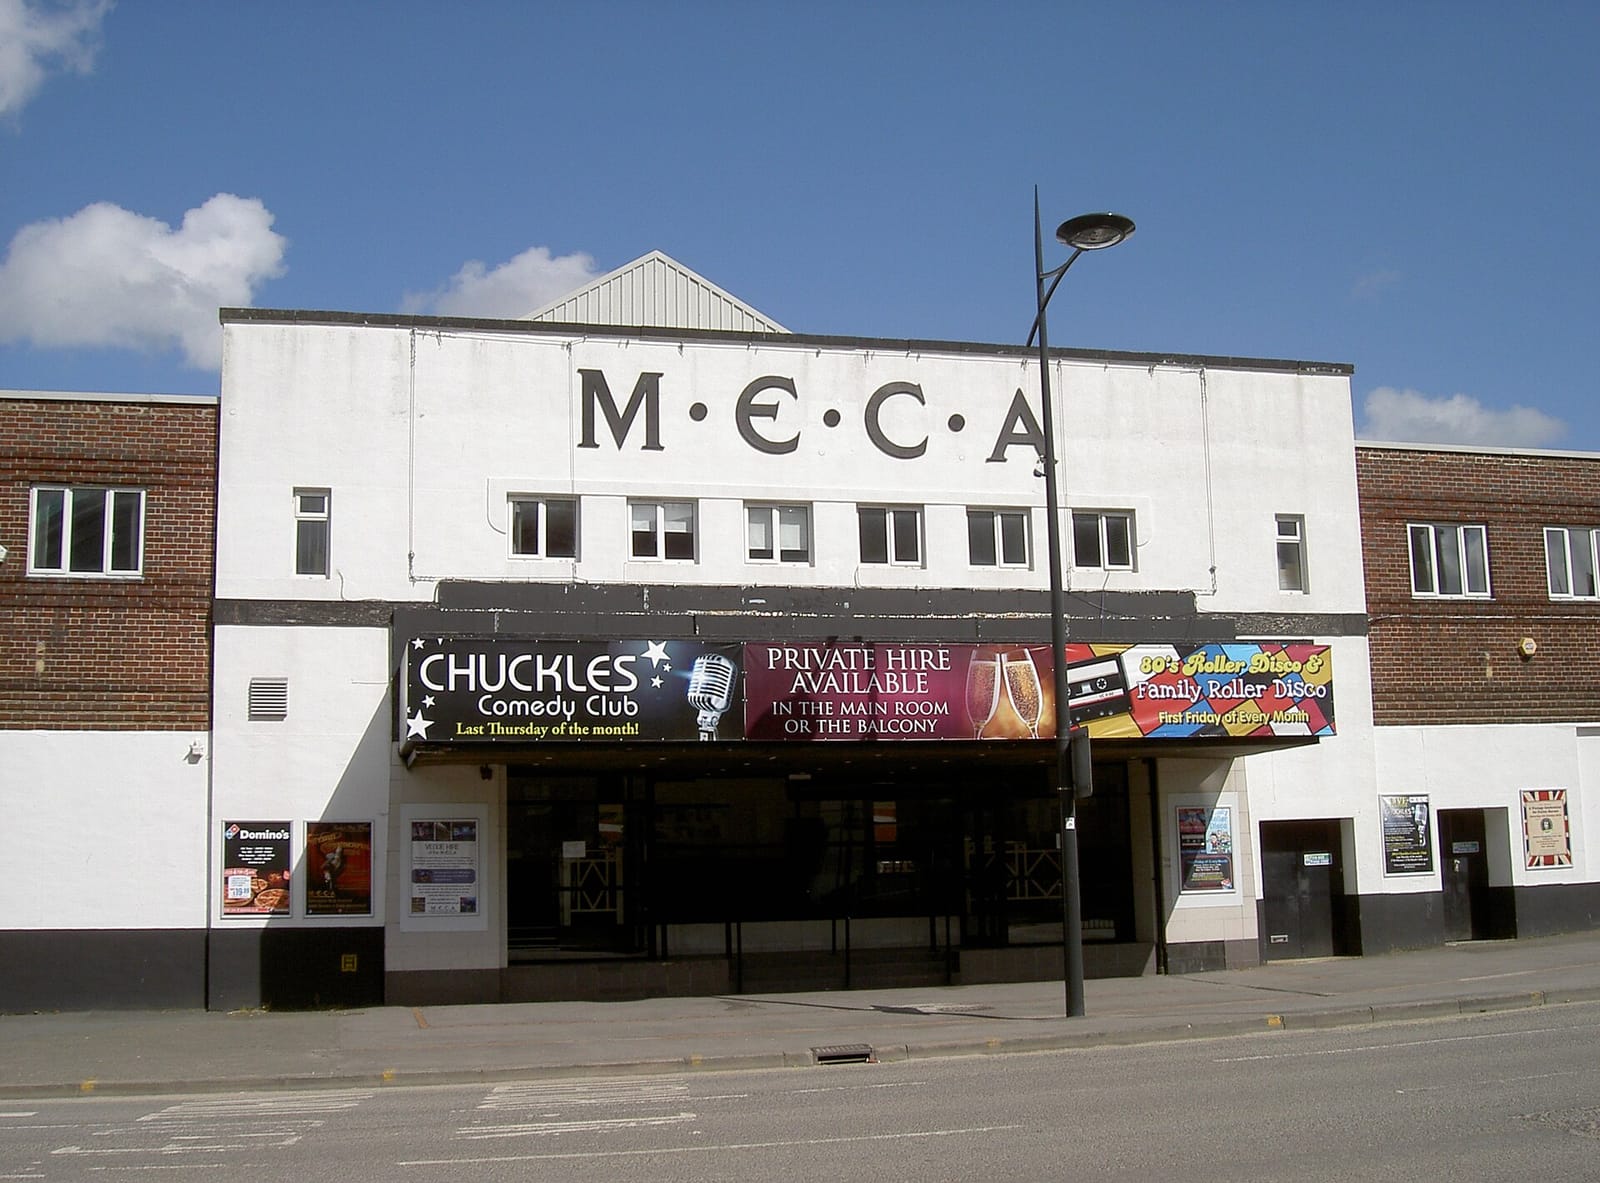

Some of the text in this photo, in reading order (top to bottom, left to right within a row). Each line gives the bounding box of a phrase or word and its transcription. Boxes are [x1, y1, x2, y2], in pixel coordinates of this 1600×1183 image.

[767, 647, 951, 671] PRIVATE HIRE
[1140, 651, 1323, 677] 80's Roller Disco &
[419, 653, 638, 692] CHUCKLES
[790, 672, 929, 694] AVAILABLE
[1137, 678, 1327, 703] Family Roller Disco
[478, 694, 639, 722] Comedy Club
[772, 701, 949, 715] IN THE MAIN ROOM
[1158, 710, 1309, 726] First Friday of Every Month
[456, 721, 639, 738] Last Thursday of the month!
[784, 719, 938, 733] OR THE BALCONY
[240, 829, 290, 840] Domino's
